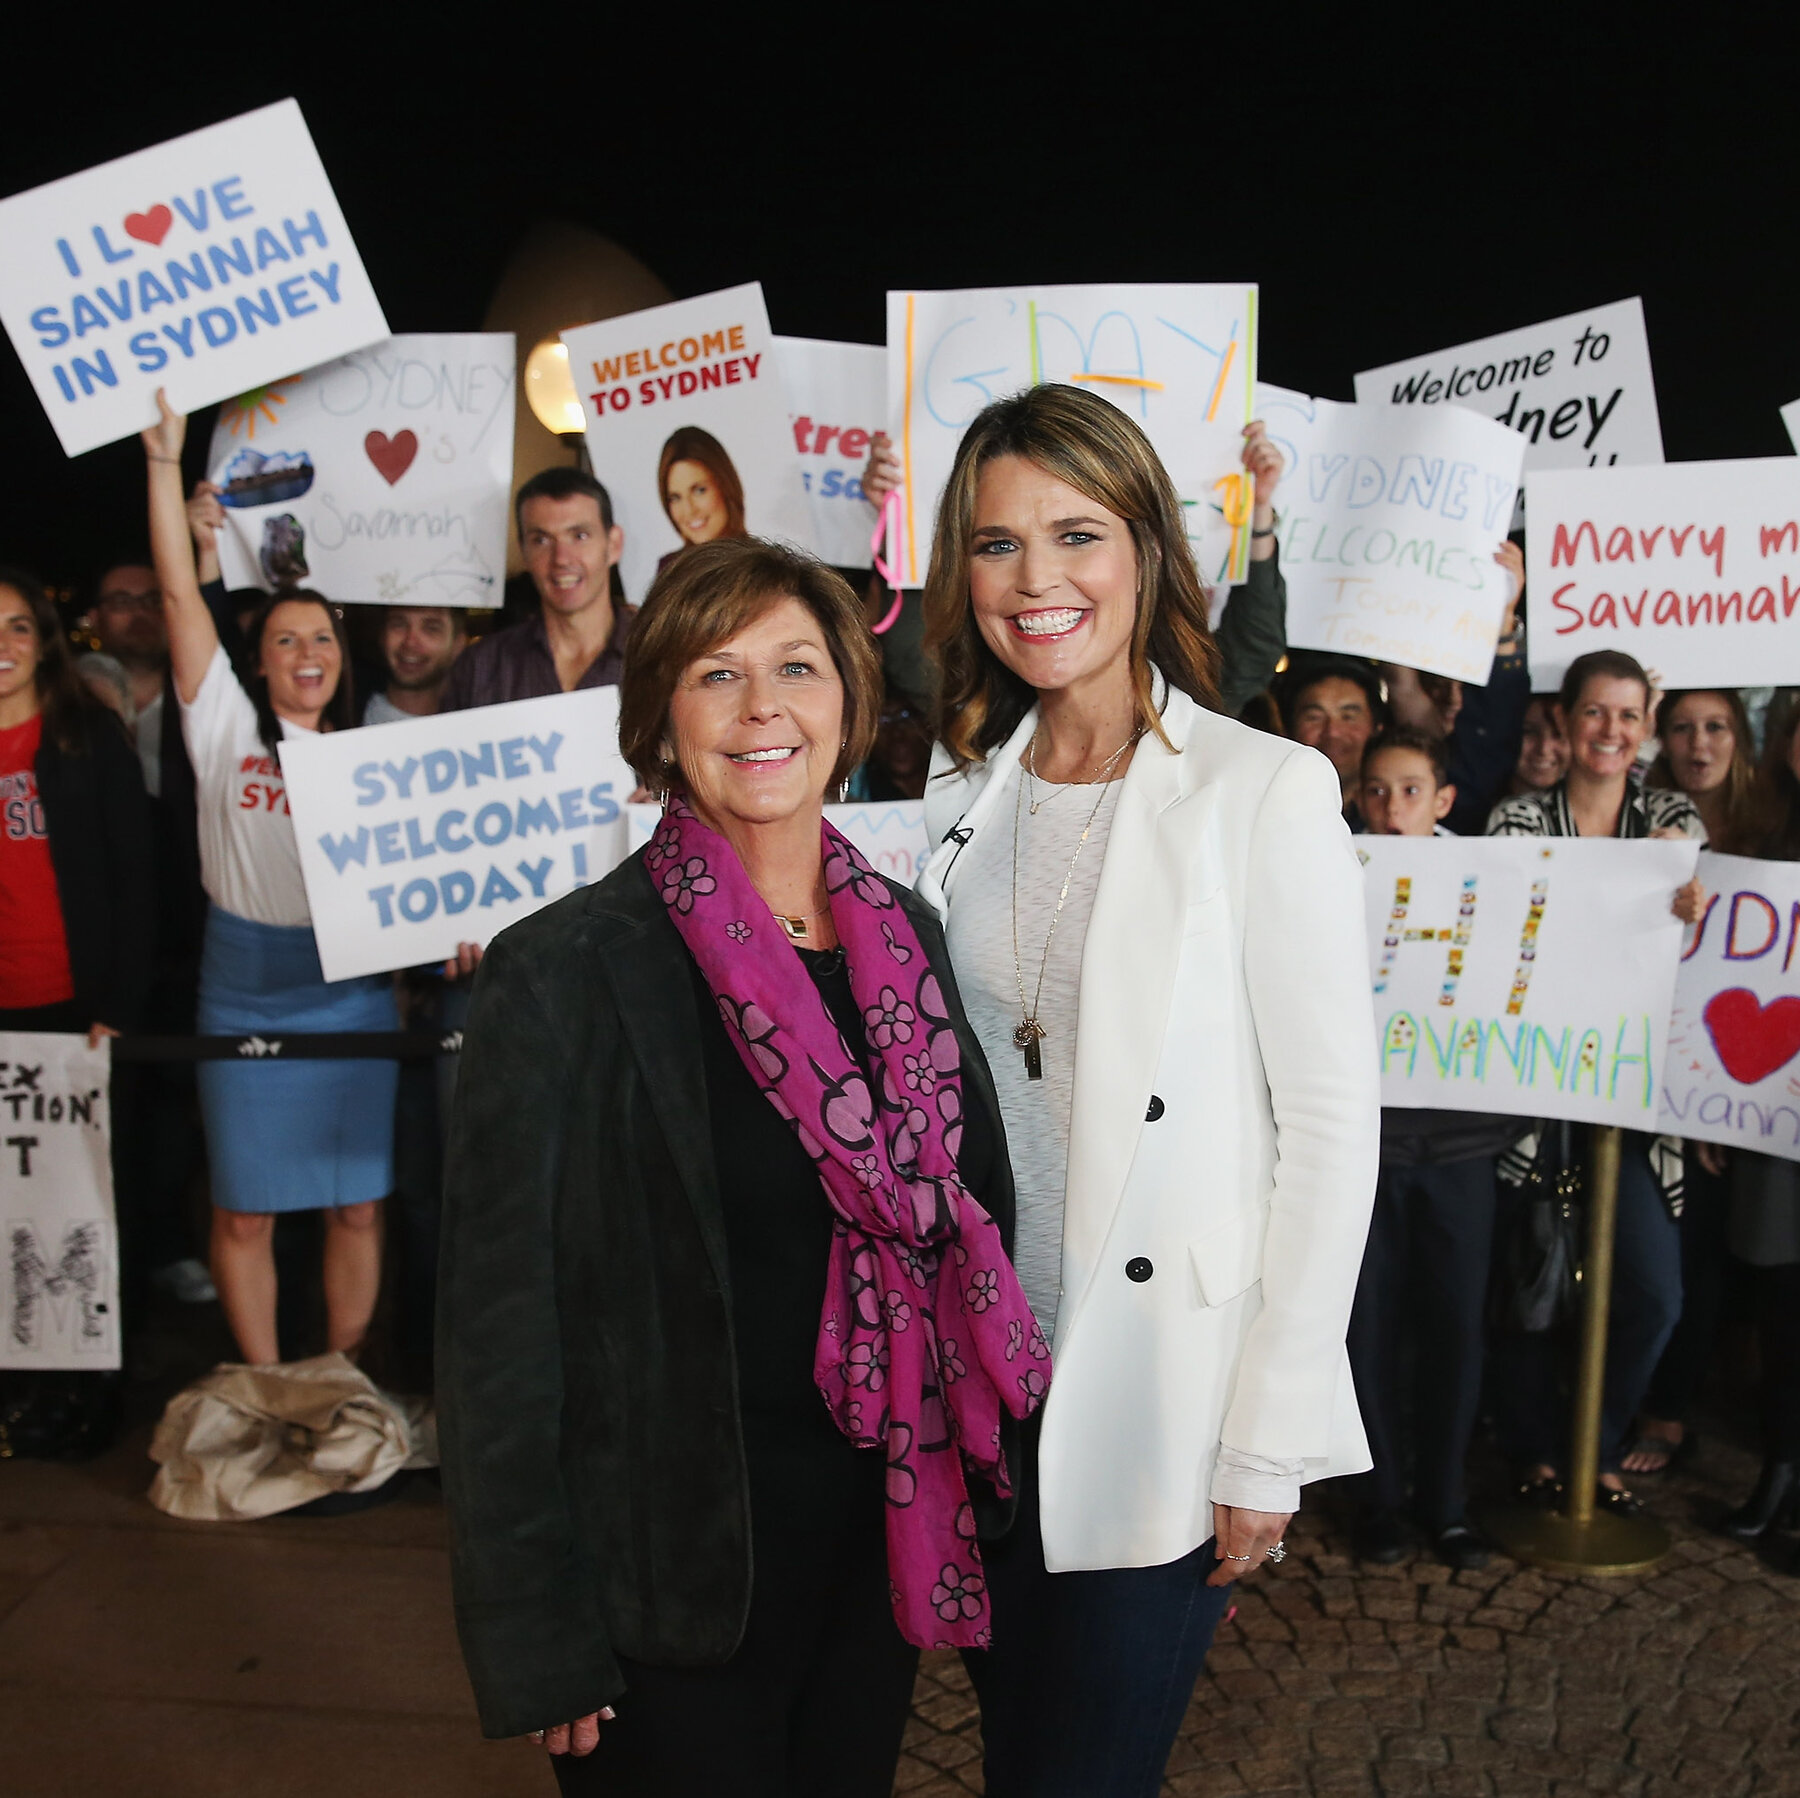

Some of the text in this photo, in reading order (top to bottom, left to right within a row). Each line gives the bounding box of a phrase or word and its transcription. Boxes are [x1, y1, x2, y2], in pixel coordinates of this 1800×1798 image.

[30, 209, 330, 349] SAVANNAH
[56, 238, 82, 278] I
[52, 262, 343, 404] IN SYDNEY
[591, 324, 747, 386] WELCOME
[1391, 327, 1611, 405] Welcome to
[318, 352, 517, 454] SYDNEY
[589, 353, 763, 417] TO SYDNEY
[308, 493, 470, 551] Savannah
[1551, 520, 1725, 577] Marry
[240, 783, 291, 816] SY
[354, 731, 567, 806] SYDNEY
[318, 782, 621, 875] WELCOMES
[368, 857, 555, 928] TODAY
[1381, 1010, 1654, 1110] AVANNAH
